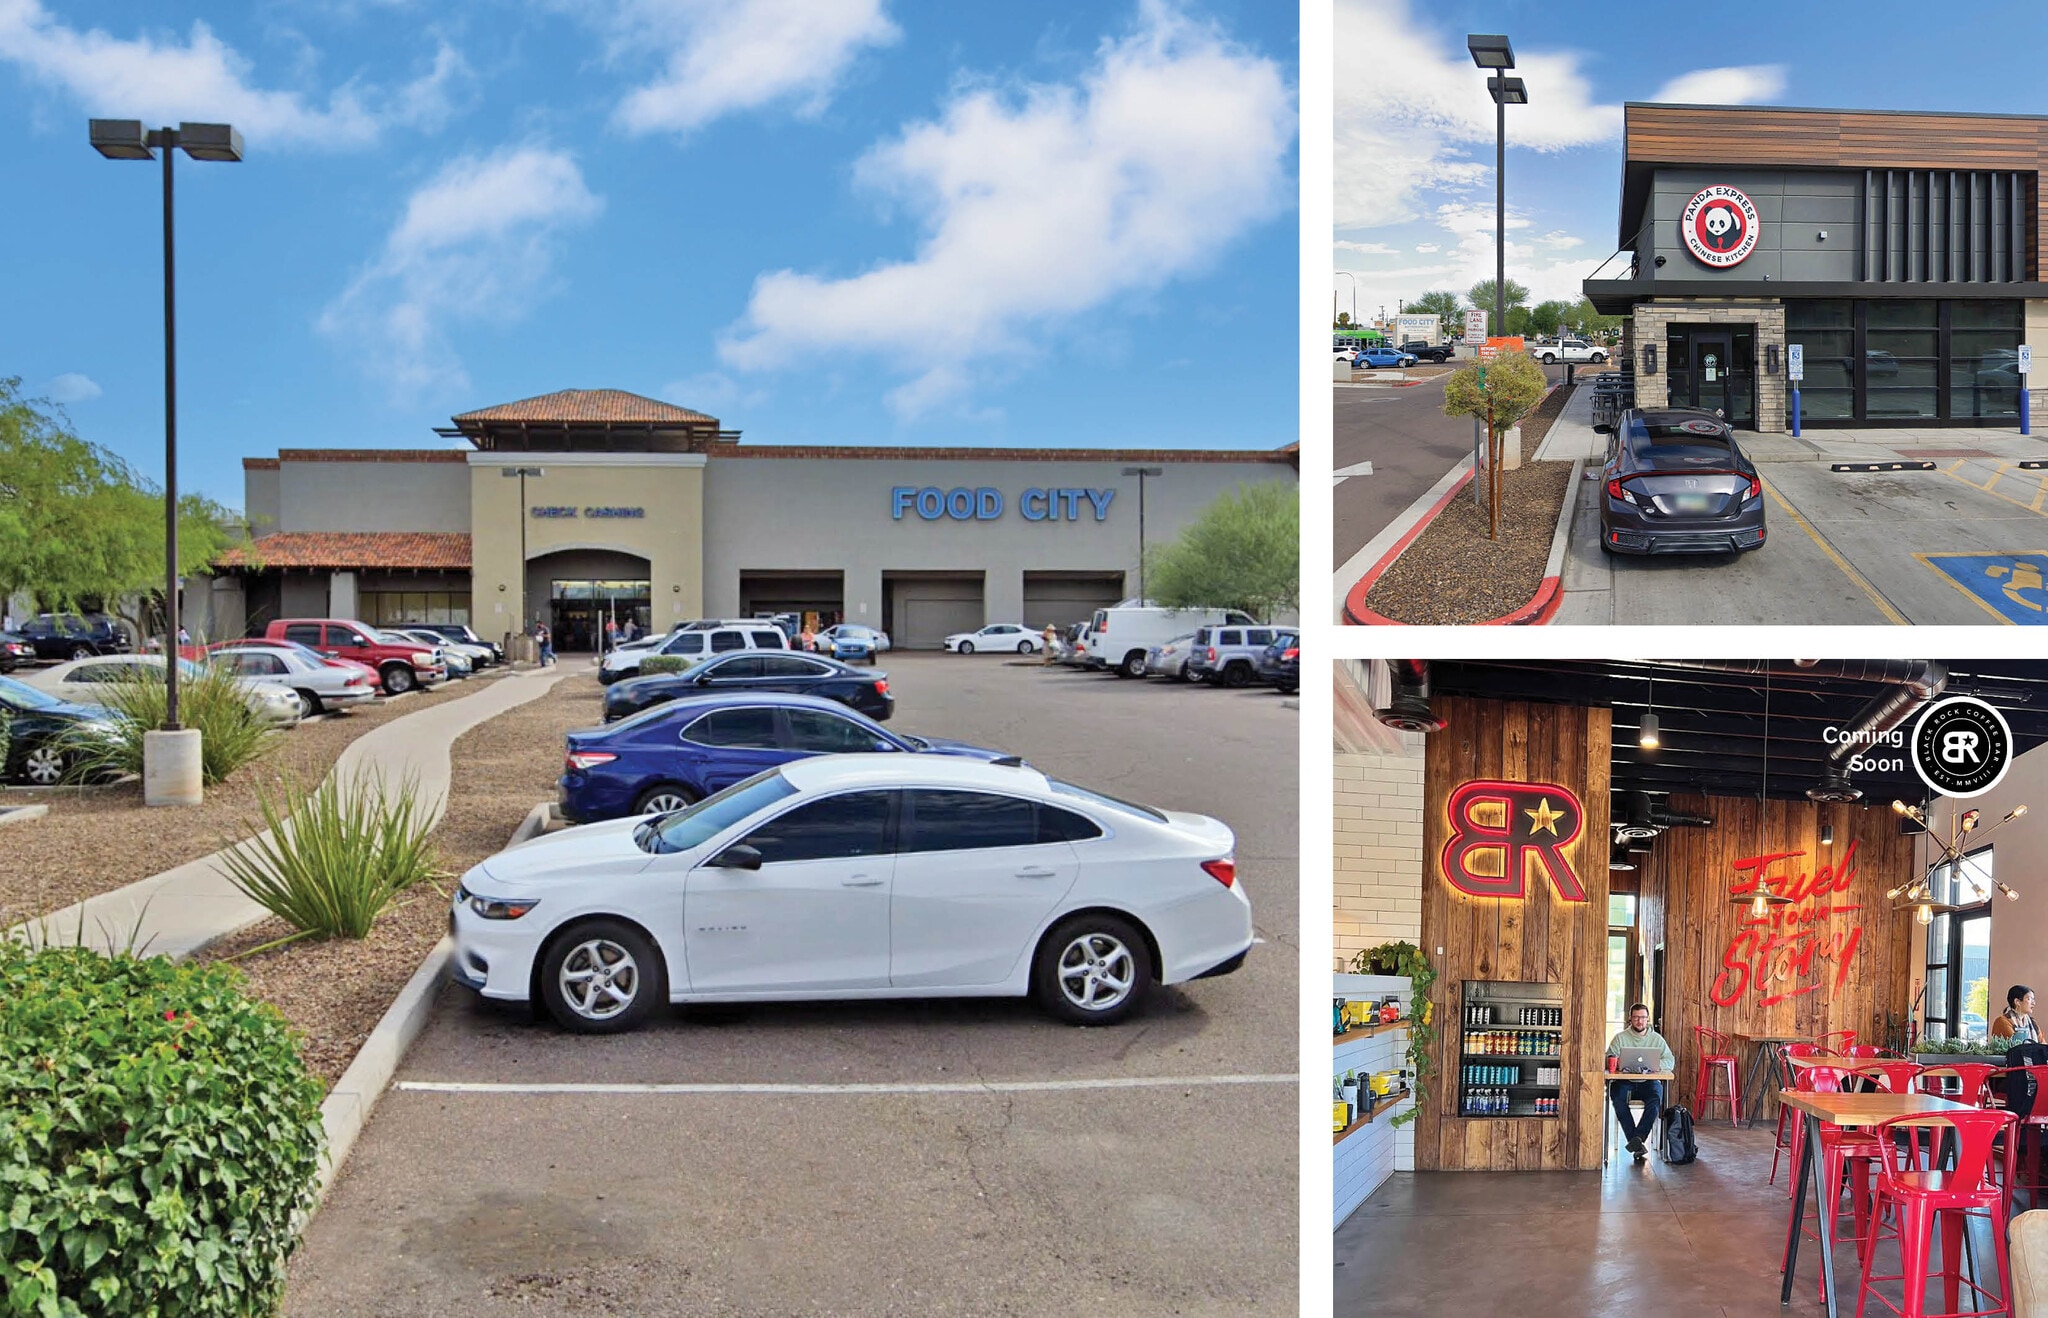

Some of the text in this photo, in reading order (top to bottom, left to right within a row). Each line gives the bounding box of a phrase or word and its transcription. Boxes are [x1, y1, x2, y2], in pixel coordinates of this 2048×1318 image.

[1685, 187, 1755, 221] PANDA EXPRESS
[1690, 234, 1754, 262] CHINESE KITCHEN
[531, 506, 578, 519] CHECK
[892, 487, 1116, 521] FOOD CITY
[1729, 839, 1860, 925] Fuel
[1772, 905, 1830, 930] YOUR
[1711, 926, 1863, 1008] Story
